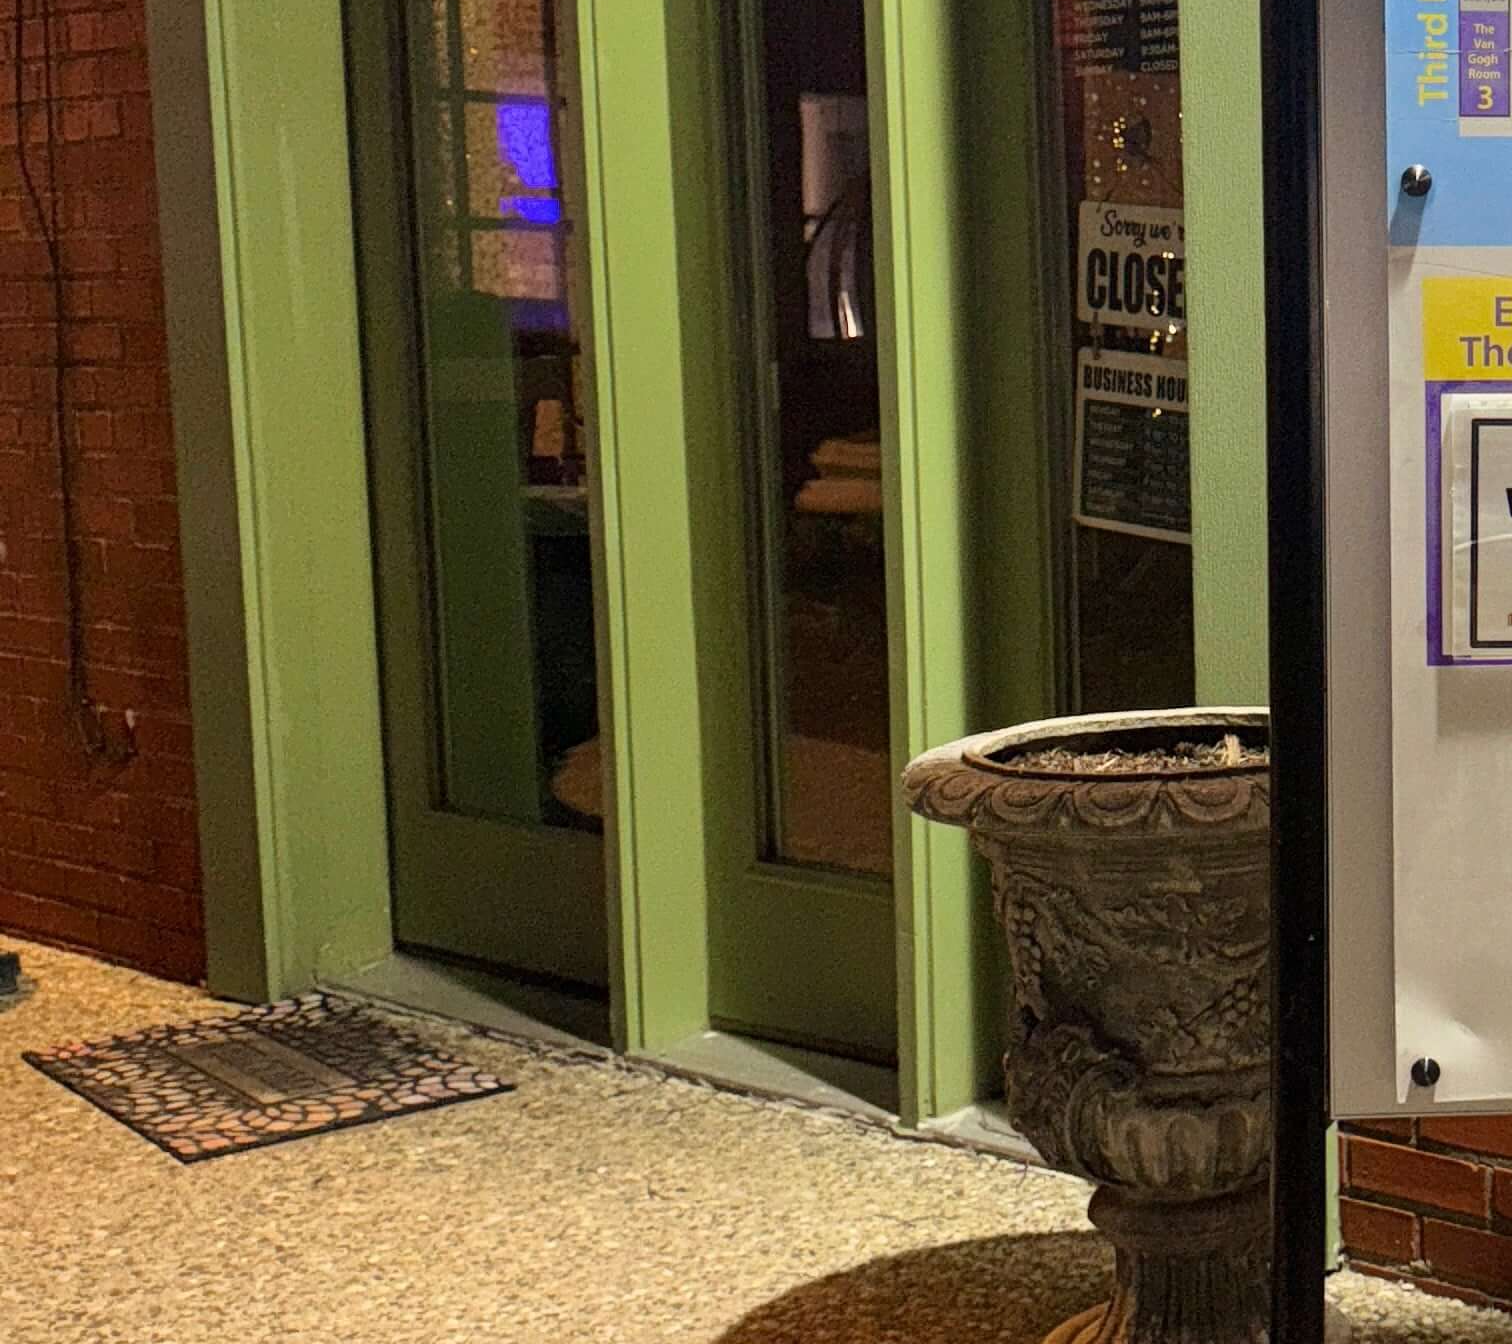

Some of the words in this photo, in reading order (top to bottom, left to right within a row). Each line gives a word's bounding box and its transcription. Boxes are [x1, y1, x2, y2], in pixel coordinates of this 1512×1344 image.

[1473, 23, 1495, 36] The
[1473, 38, 1495, 50] Van
[1417, 13, 1449, 107] Third
[1468, 53, 1499, 67] Gogh
[1468, 69, 1501, 80] Room
[1477, 86, 1493, 110] 3
[1100, 209, 1147, 247] Sorry
[1150, 221, 1184, 241] we'r
[1086, 248, 1184, 318] CLOSE
[1083, 364, 1153, 398] BUSINESS
[1156, 372, 1188, 402] HOU
